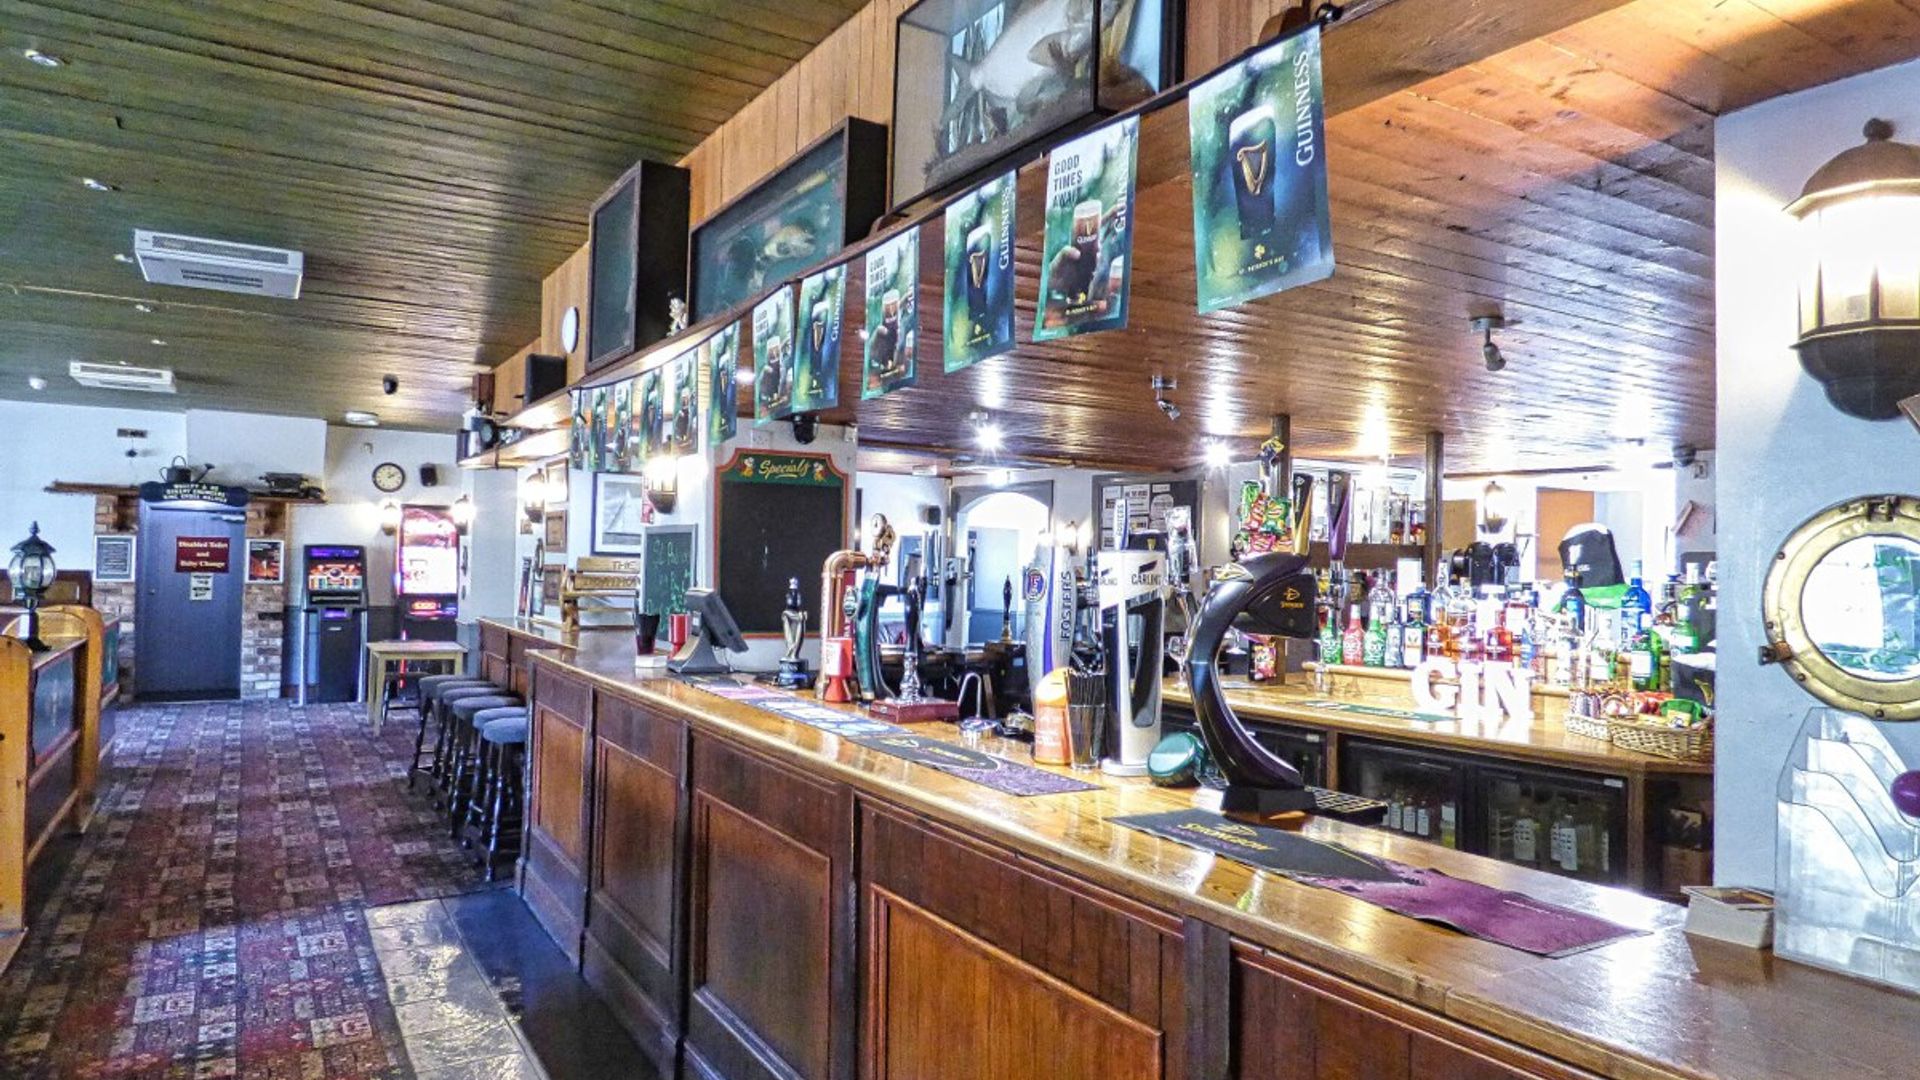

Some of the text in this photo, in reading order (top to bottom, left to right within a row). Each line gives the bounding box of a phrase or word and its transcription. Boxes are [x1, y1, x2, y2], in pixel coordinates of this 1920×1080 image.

[1293, 50, 1315, 167] GUINNESS
[1053, 153, 1080, 176] GOOD
[1052, 169, 1083, 193] TIMES
[998, 184, 1013, 270] GUINNESS
[759, 459, 812, 480] Specials
[199, 560, 225, 568] Change
[611, 559, 637, 570] THE
[1059, 570, 1072, 639] FOSTER'S
[1410, 655, 1535, 722] GIN
